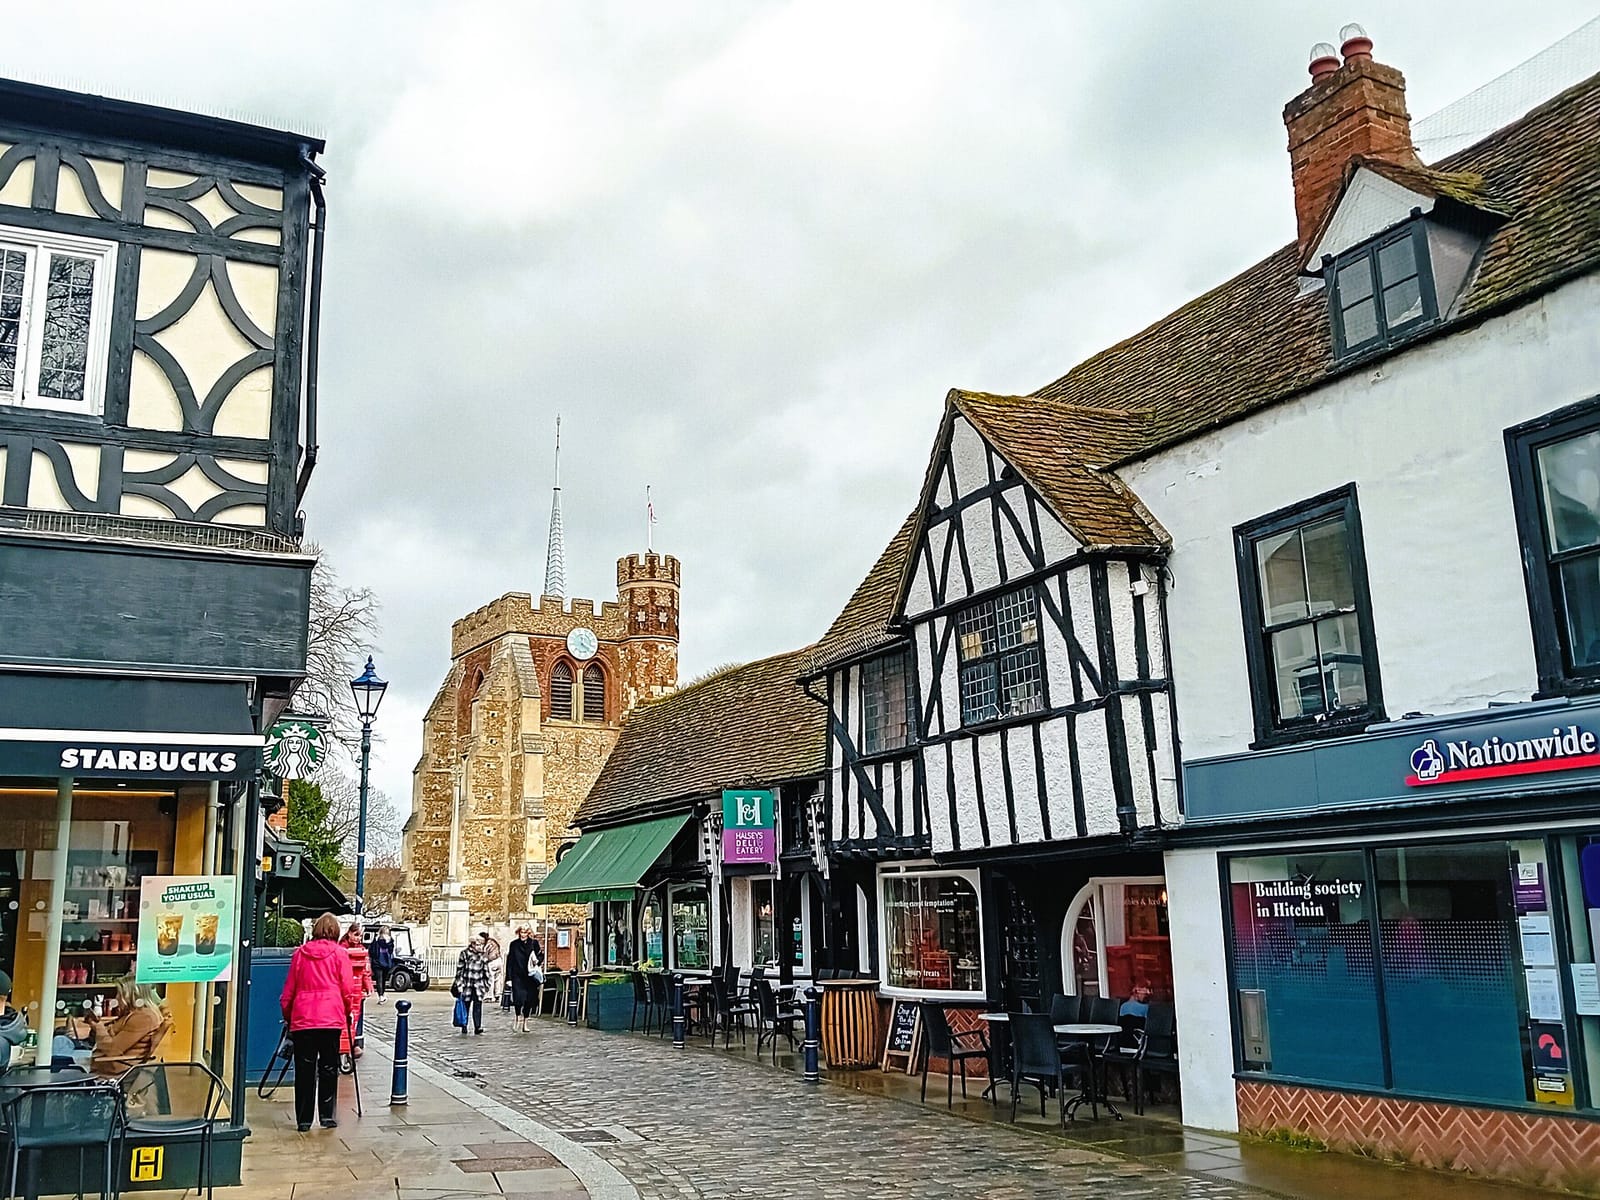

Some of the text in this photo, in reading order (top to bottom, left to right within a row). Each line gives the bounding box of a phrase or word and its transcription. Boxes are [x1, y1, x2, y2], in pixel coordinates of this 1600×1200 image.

[1446, 725, 1596, 769] Nationwide
[60, 748, 237, 773] STARBUCKS
[735, 839, 756, 847] DELI
[735, 846, 764, 855] EATERY
[163, 891, 214, 901] YOUR USUAL
[168, 883, 208, 895] SHAKE UP
[1255, 878, 1362, 900] Building society
[1256, 901, 1325, 917] in Hitchin
[135, 1149, 159, 1178] H
